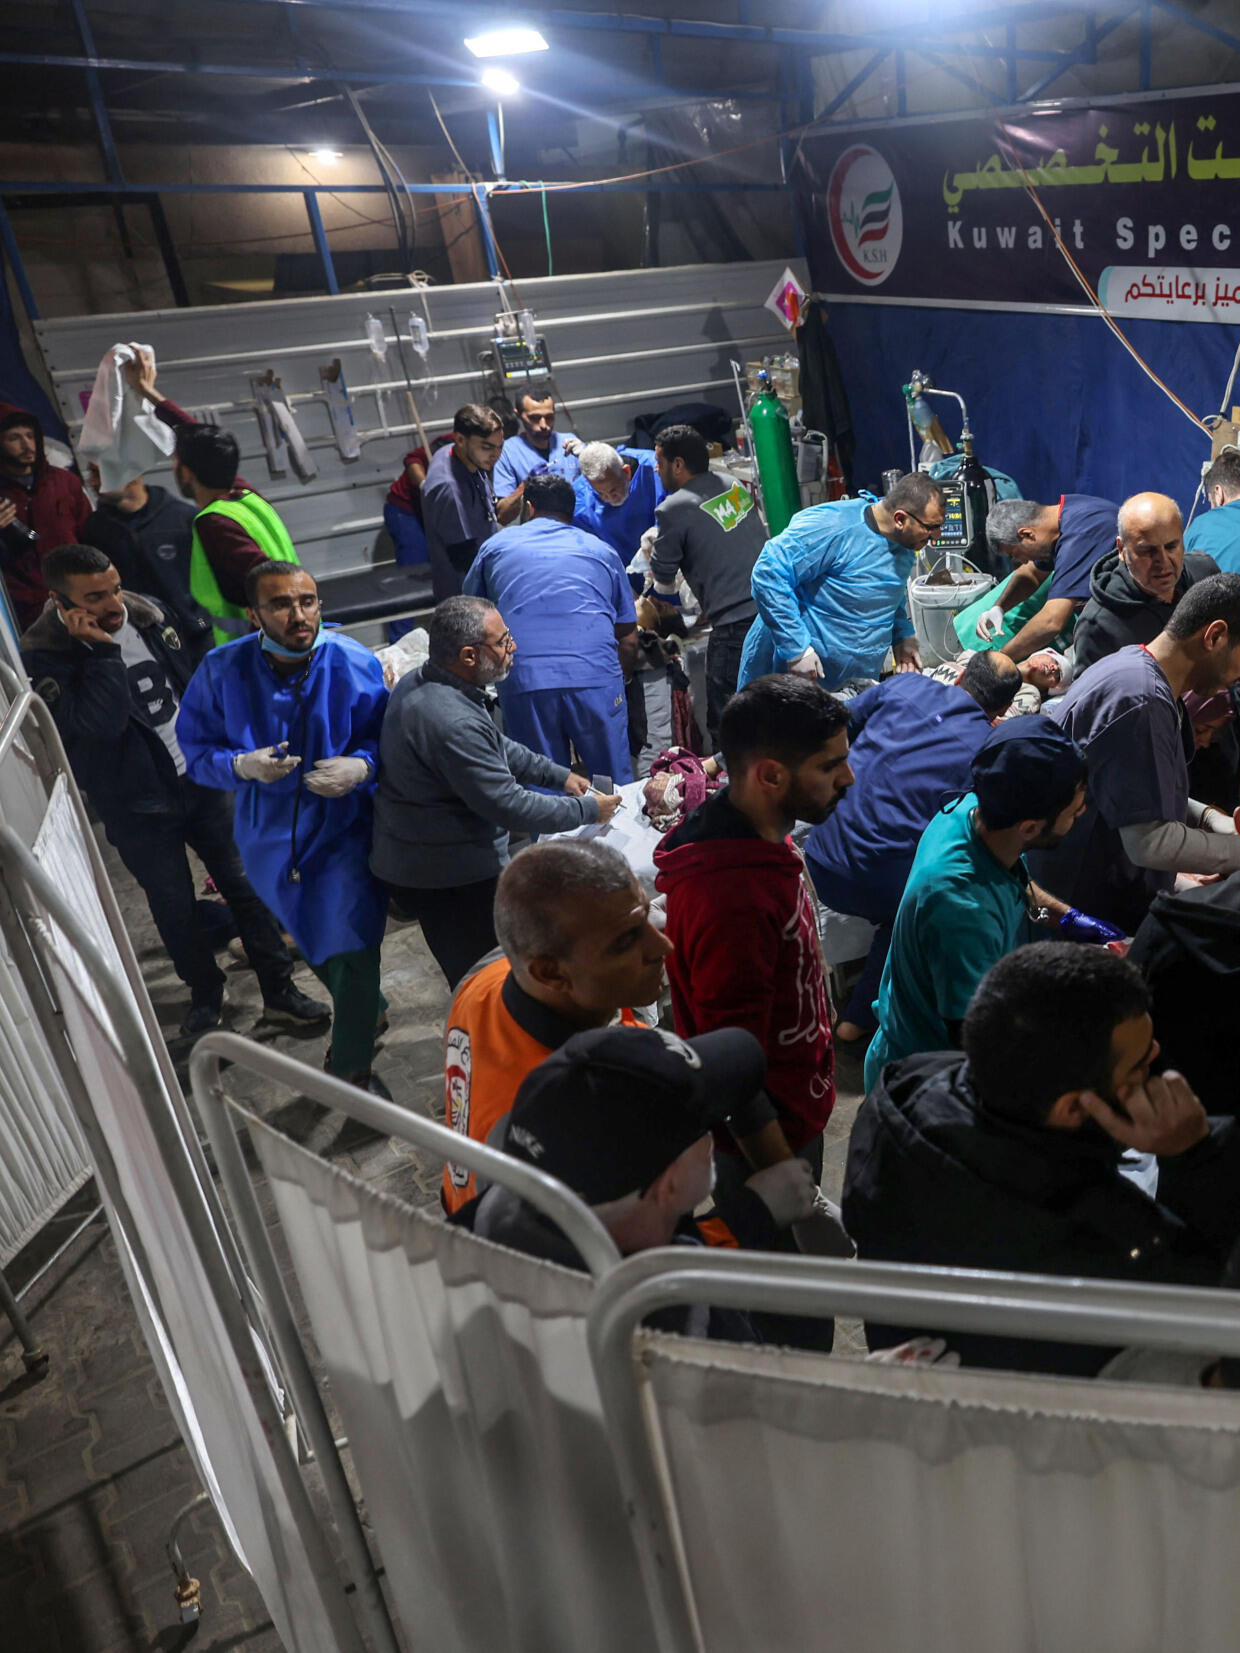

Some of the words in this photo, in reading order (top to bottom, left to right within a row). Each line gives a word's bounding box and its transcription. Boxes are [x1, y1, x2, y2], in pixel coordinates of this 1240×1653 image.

[942, 121, 1178, 213] التخصصي
[946, 217, 1085, 250] Kuwait
[1124, 274, 1206, 308] برعايتكم
[508, 1123, 545, 1159] NIKE
